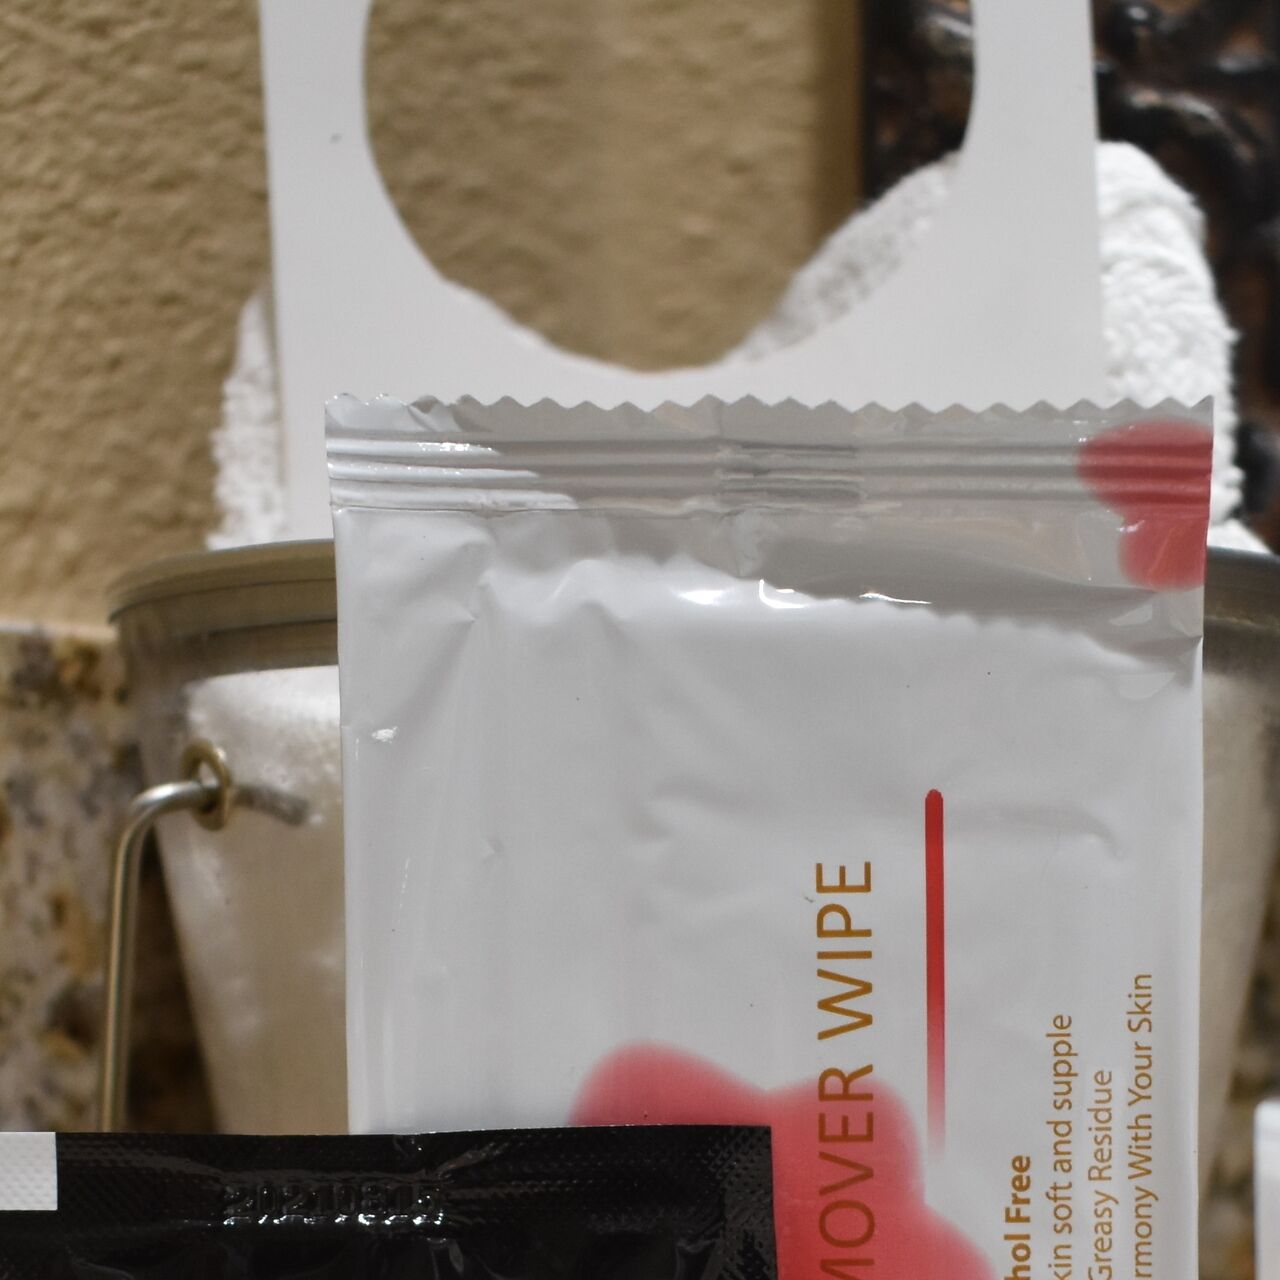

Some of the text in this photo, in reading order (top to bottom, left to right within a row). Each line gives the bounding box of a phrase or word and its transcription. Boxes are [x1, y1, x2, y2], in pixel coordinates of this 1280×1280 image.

[815, 860, 874, 1040] WIPE
[1126, 973, 1153, 1032] Skin
[1045, 1013, 1079, 1110] supple
[1127, 1040, 1153, 1106] Your
[1045, 1119, 1073, 1173] and
[1087, 1069, 1113, 1181] Residue
[1126, 1112, 1153, 1179] With
[1004, 1154, 1032, 1223] Free
[1045, 1180, 1073, 1234] soft
